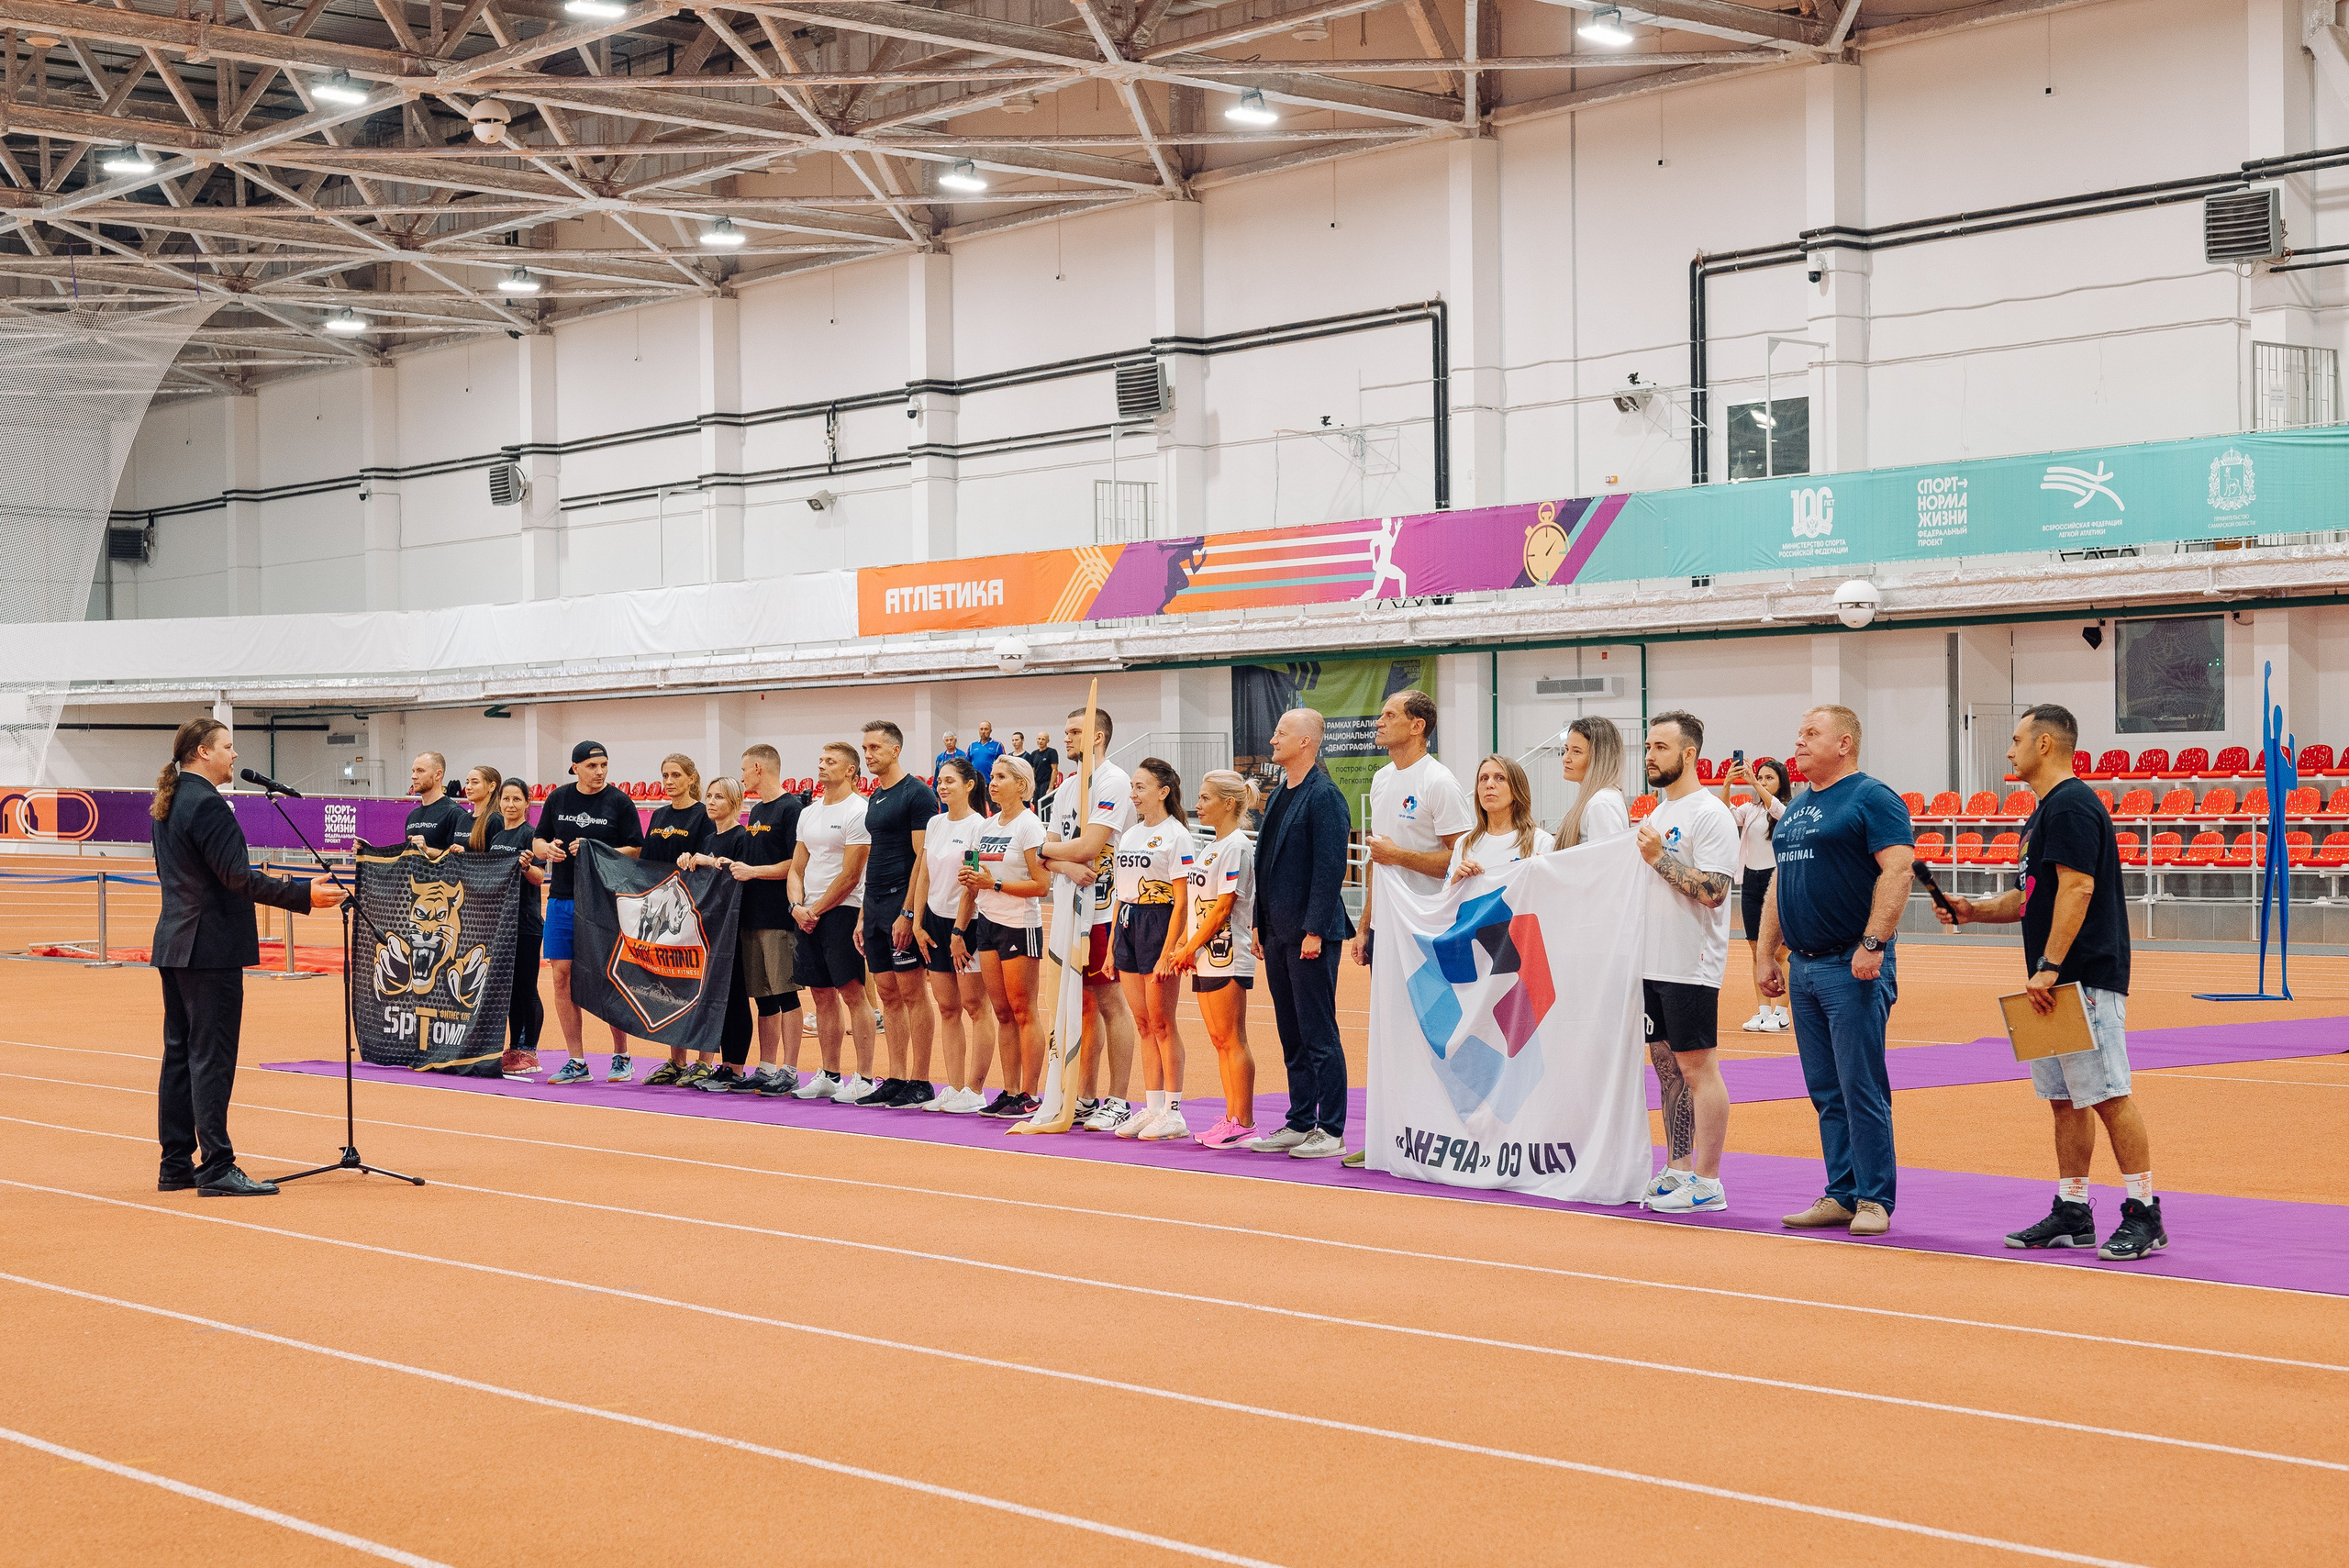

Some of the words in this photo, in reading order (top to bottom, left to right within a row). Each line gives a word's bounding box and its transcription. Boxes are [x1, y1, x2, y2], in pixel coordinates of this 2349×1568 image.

[1917, 476, 1958, 495] СПОРТ
[1917, 492, 1967, 511] НОРМА
[1918, 508, 1967, 528] ЖИЗНИ
[2042, 521, 2090, 531] ВСЕРОССИЙСКАЯ
[2091, 518, 2123, 528] ФЕДЕРАЦИЯ
[1917, 525, 1967, 539] ФЕДЕРАЛЬНЫЙ
[1782, 541, 1824, 550] МИНИСТЕРСТВО
[1825, 539, 1846, 547] СПОРТА
[1918, 538, 1943, 547] ПРОЕКТ
[1778, 548, 1814, 558] РОССИЙСКОЙ
[1814, 546, 1849, 555] ФЕДЕРАЦИИ
[885, 579, 1004, 614] АТЛЕТИКА
[1324, 730, 1377, 741] НАЦИОНАЛЬНОГ
[324, 805, 351, 815] СПОРТ
[1784, 806, 1823, 827] MUSTANG
[324, 814, 356, 824] НОРМА
[324, 824, 356, 833] ЖИЗНИ
[1777, 848, 1815, 863] ORIGINAL
[654, 947, 700, 969] RHINO
